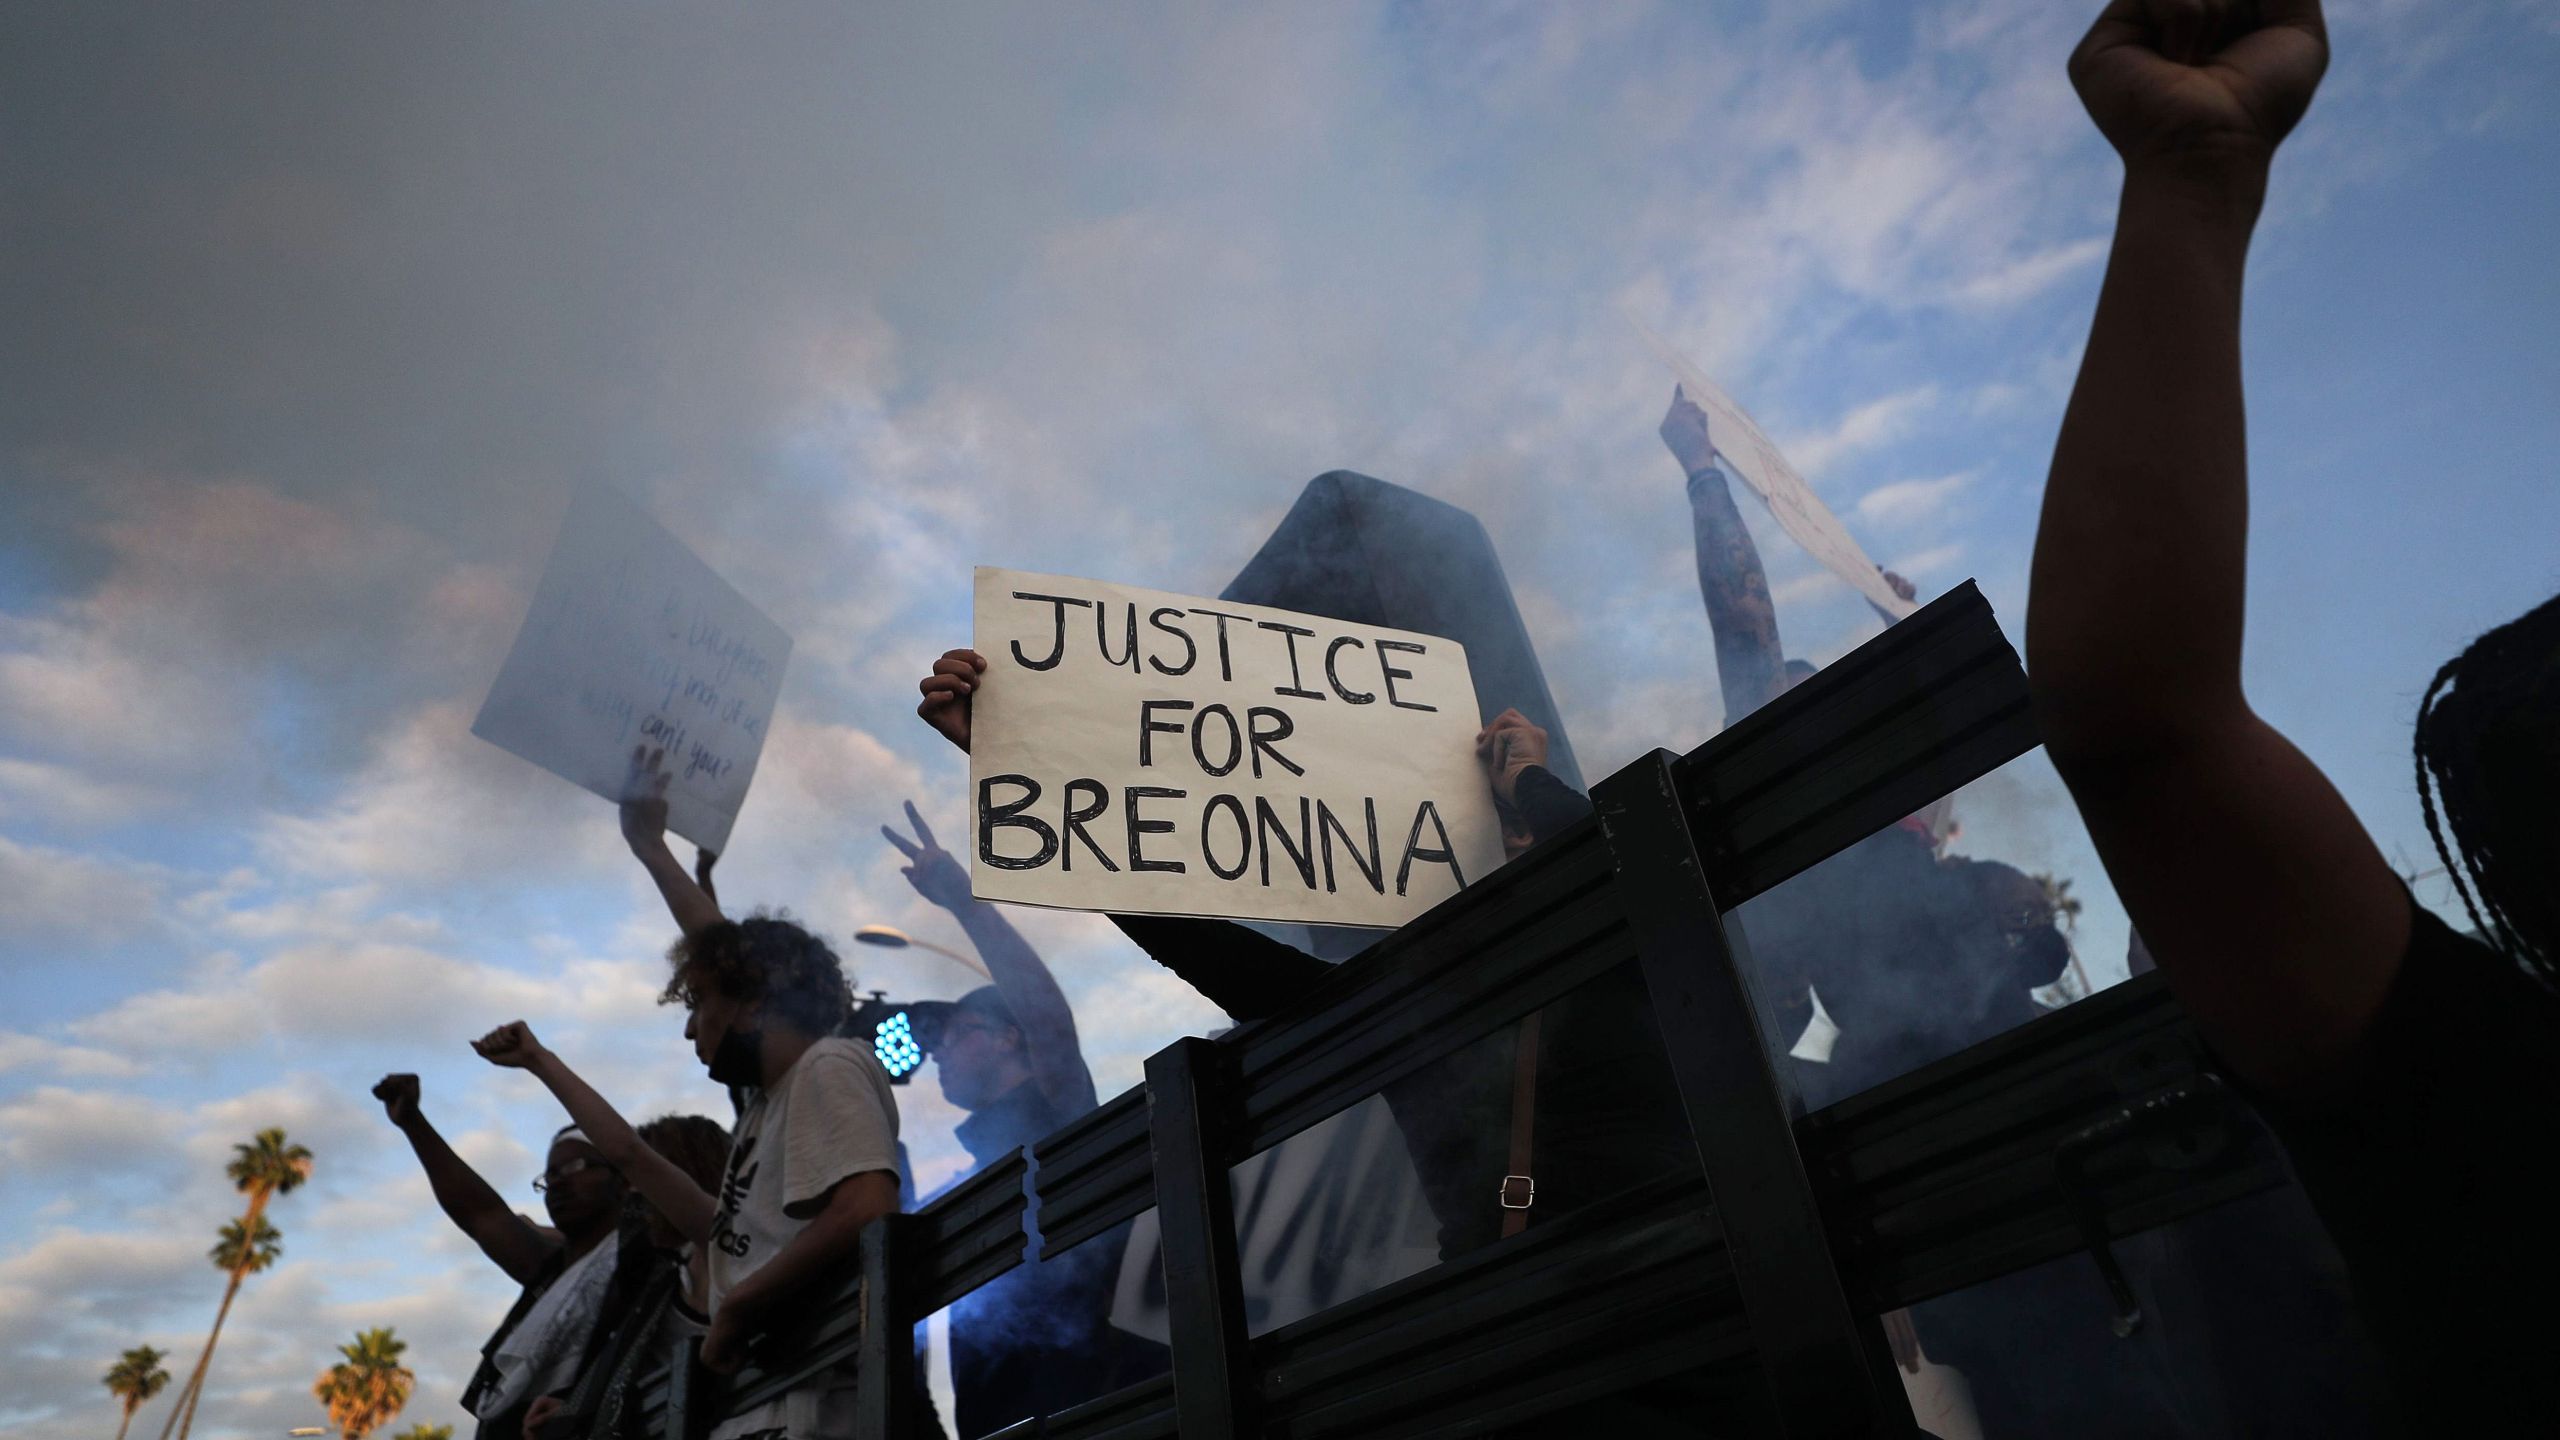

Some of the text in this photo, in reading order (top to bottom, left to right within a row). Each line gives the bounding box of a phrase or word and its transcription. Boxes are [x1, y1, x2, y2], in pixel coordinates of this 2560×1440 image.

[1010, 591, 1438, 713] JUSTICE
[640, 714, 687, 756] can't
[684, 741, 733, 780] you?
[1139, 700, 1305, 778] FOR
[978, 774, 1468, 896] BREONNA
